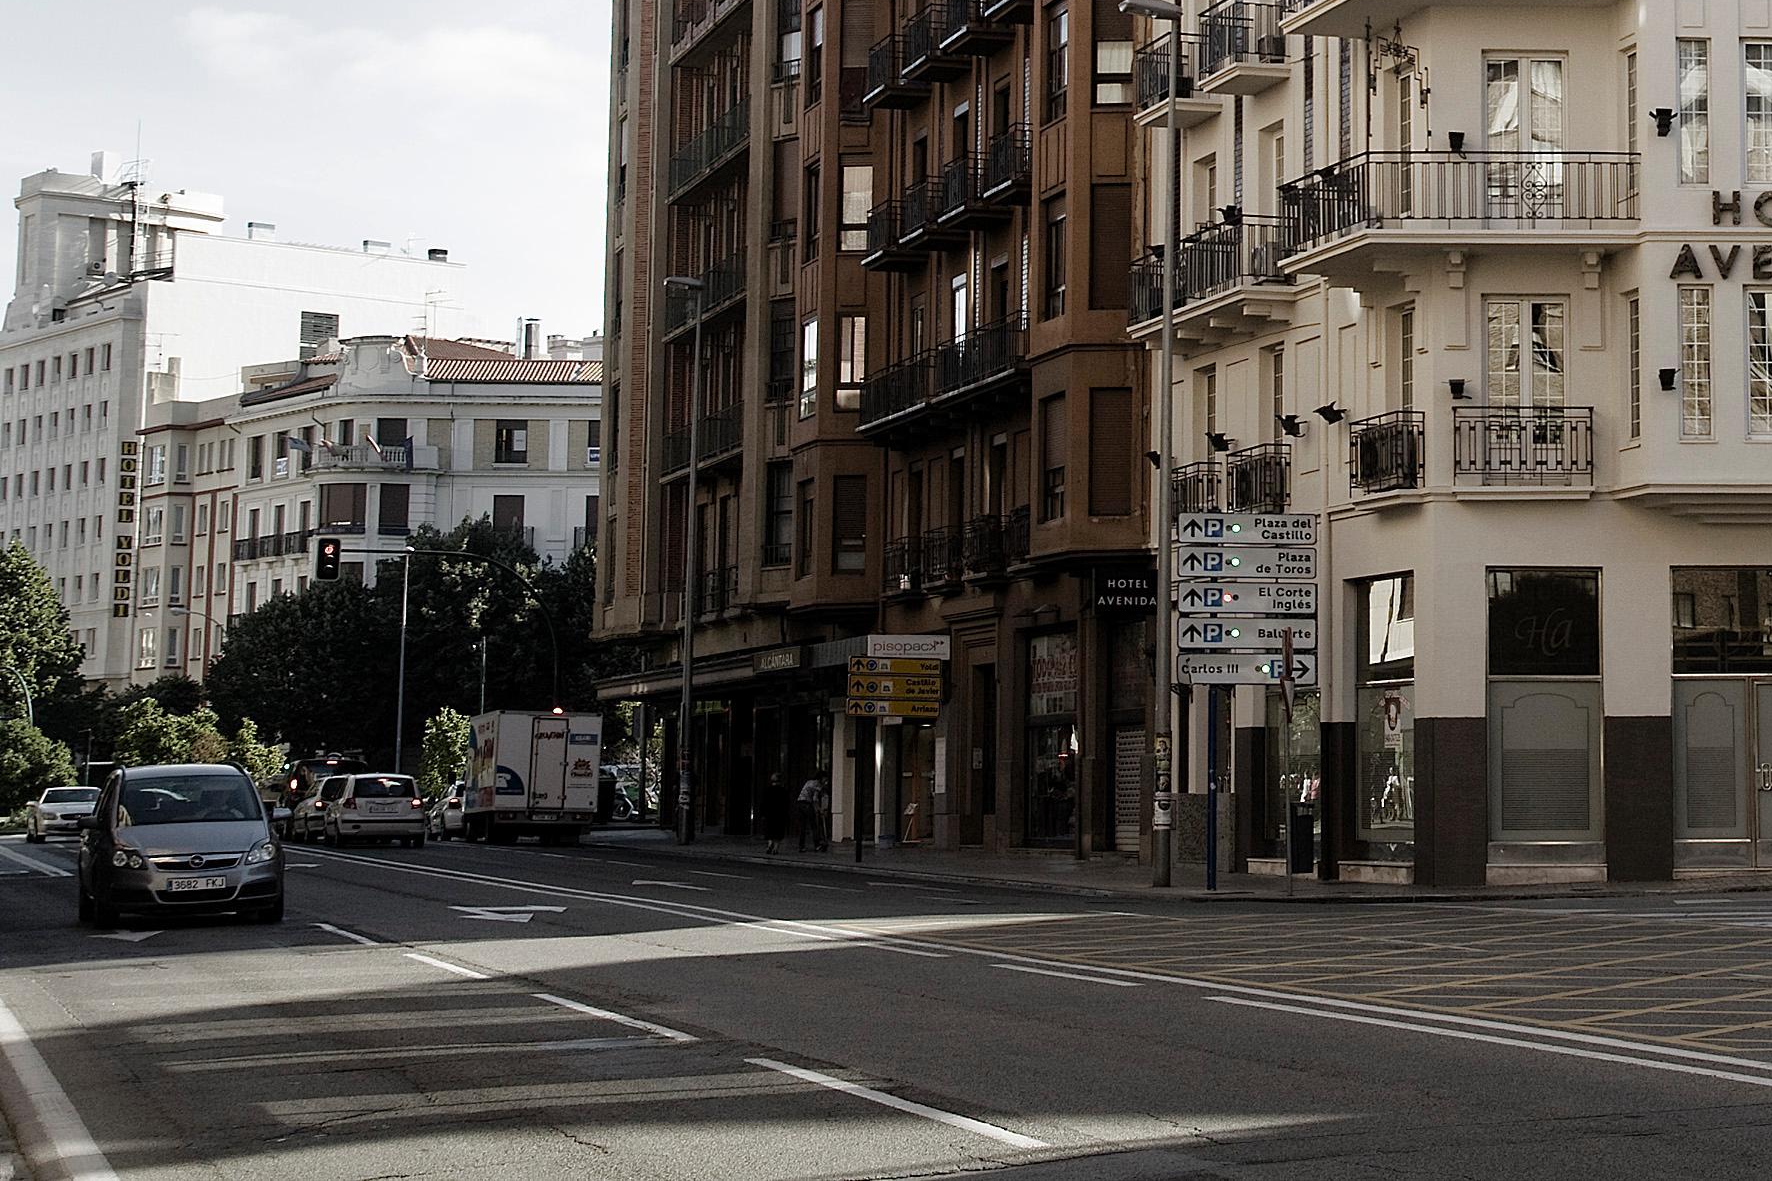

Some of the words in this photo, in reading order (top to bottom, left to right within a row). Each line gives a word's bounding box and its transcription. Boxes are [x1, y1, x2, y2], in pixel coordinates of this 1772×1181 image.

[119, 442, 136, 522] HOTEL
[1254, 519, 1288, 528] Plaza
[1292, 518, 1312, 528] del
[1261, 530, 1312, 540] Castillo
[1278, 552, 1311, 562] Plaza
[1256, 564, 1271, 574] de
[1276, 564, 1311, 574] Toros
[116, 536, 131, 616] YOLDI
[1107, 580, 1149, 588] HOTEL
[1259, 588, 1271, 597] El
[1276, 588, 1312, 597] Corte
[1097, 596, 1157, 605] AVENIDA
[1273, 600, 1312, 611] Inglés
[1258, 629, 1311, 638] Balurte
[920, 663, 938, 671] Yoldi
[1182, 664, 1222, 674] Carlos
[1227, 664, 1239, 674] III
[206, 878, 224, 887] FKJ
